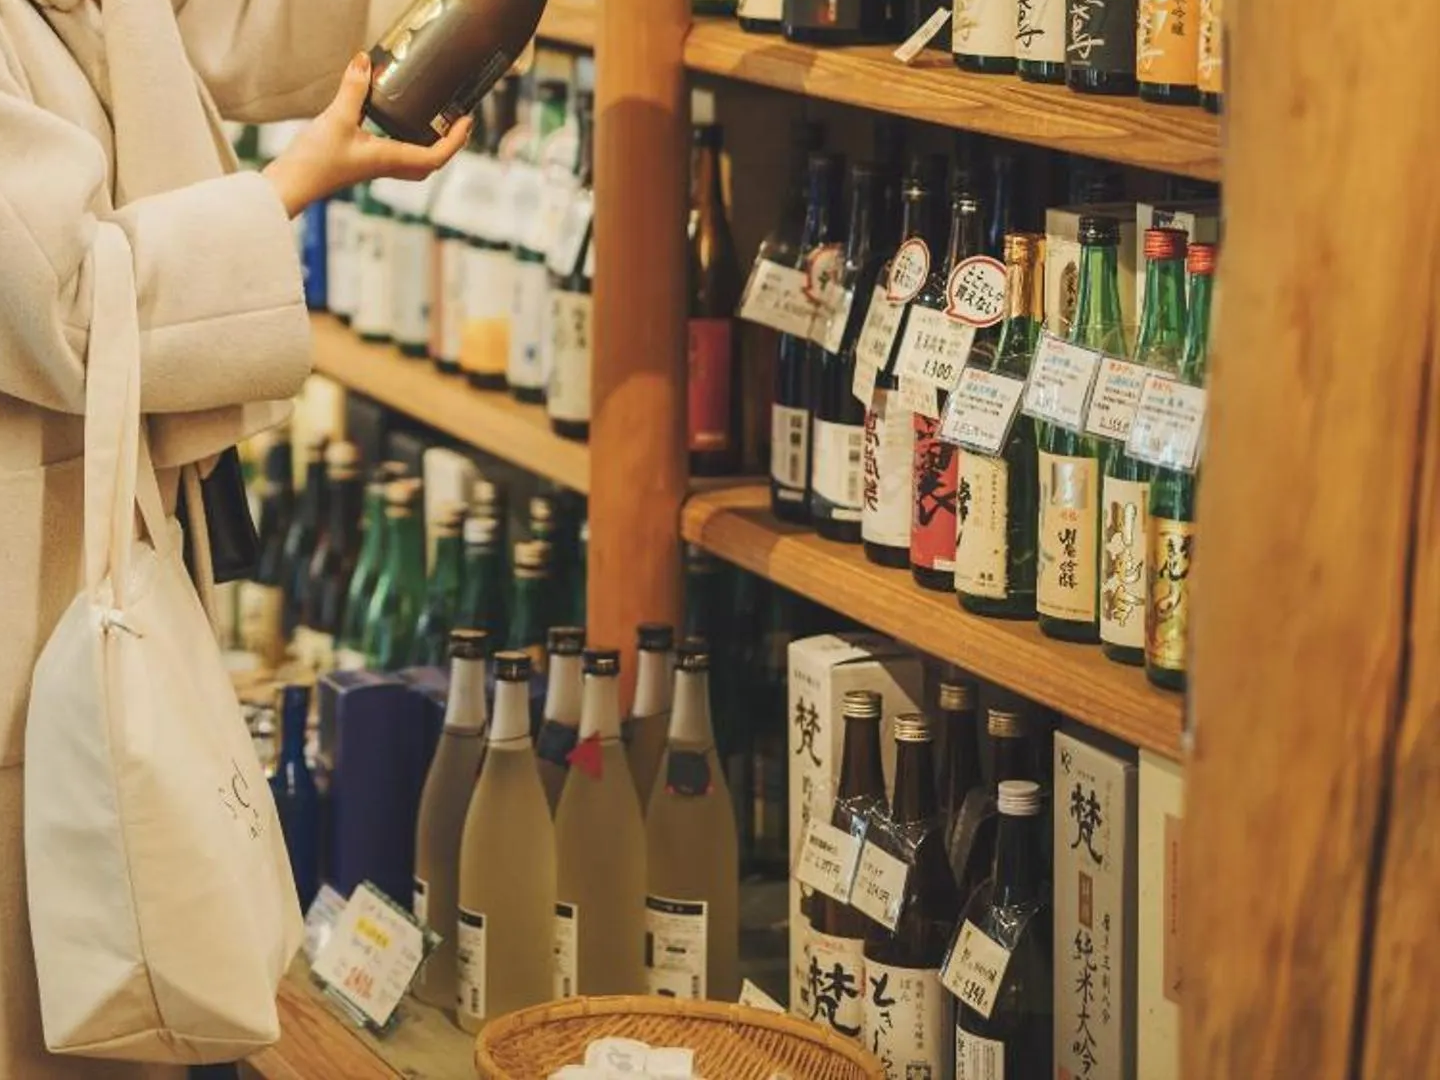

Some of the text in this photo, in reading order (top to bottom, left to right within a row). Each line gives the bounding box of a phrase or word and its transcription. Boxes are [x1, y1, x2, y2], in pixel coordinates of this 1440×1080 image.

[955, 283, 998, 315] 買えない
[963, 265, 1004, 302] ここでしか
[795, 696, 822, 767] 梵
[1071, 782, 1103, 865] 梵
[809, 956, 862, 1038] 梵
[1073, 929, 1098, 1080] 純米大吟
